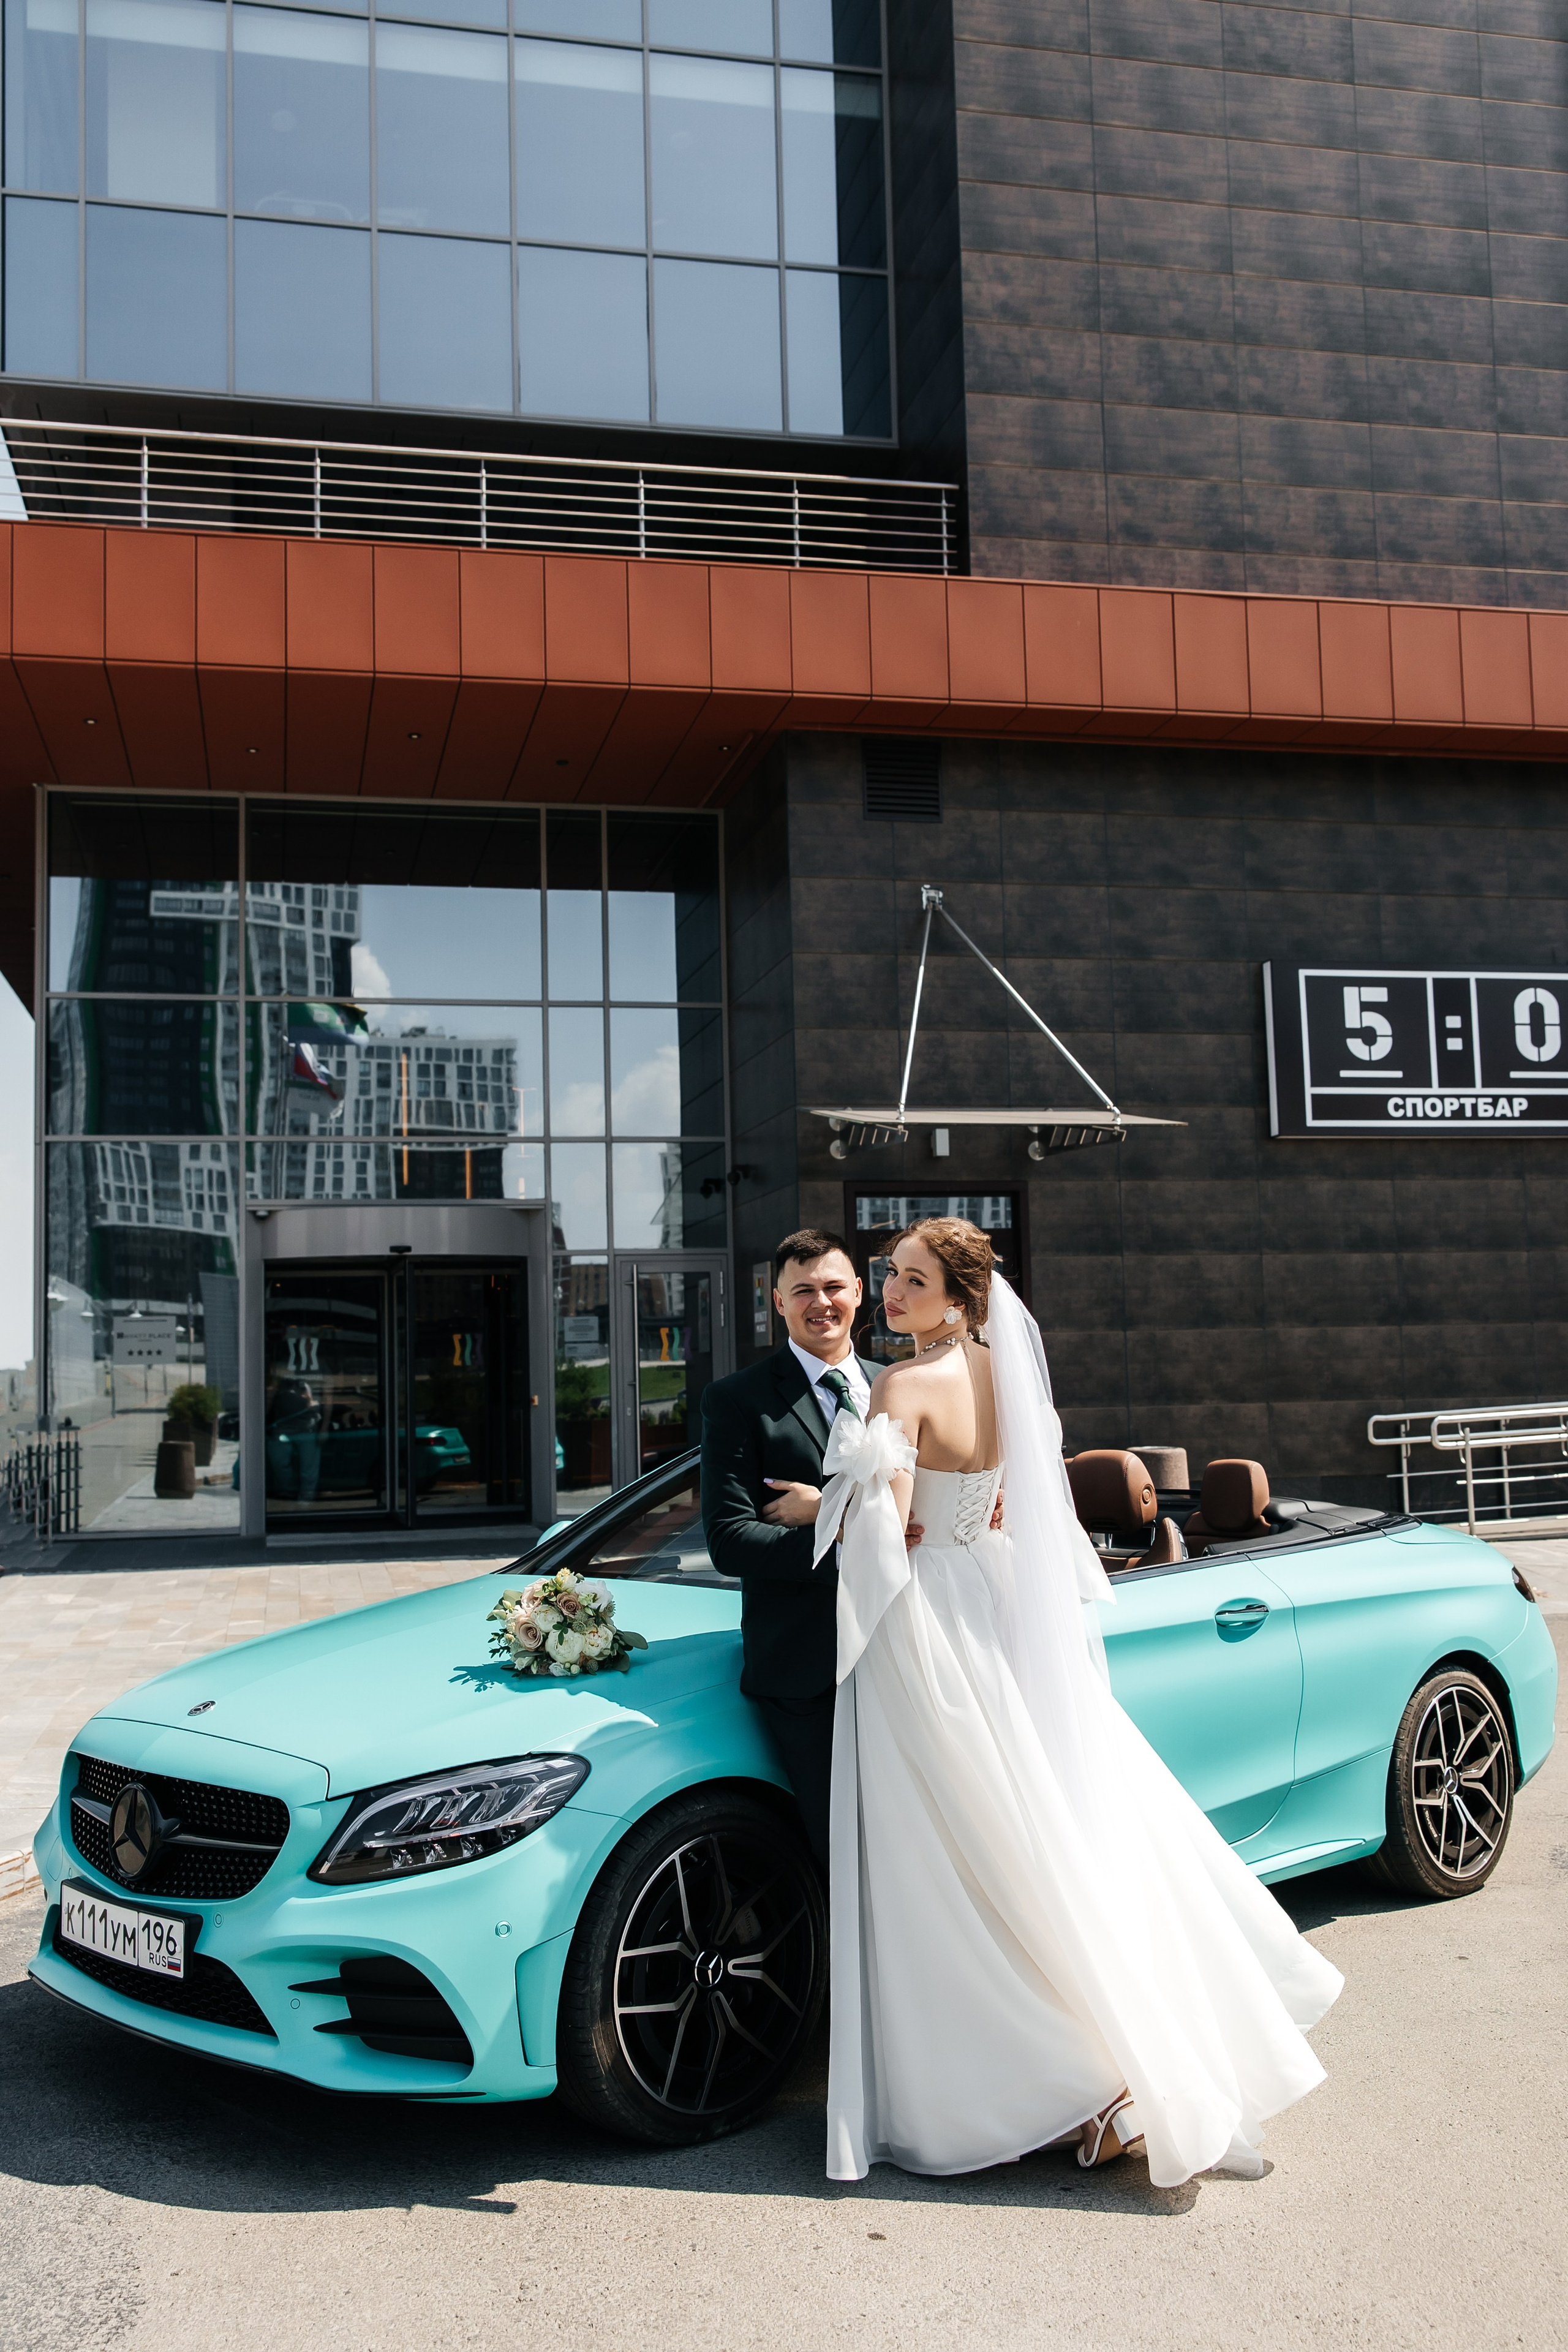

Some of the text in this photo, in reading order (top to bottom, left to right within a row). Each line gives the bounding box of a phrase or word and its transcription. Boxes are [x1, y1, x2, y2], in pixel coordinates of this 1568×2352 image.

[1343, 986, 1393, 1061] 5
[1513, 987, 1562, 1062] 0
[1387, 1096, 1529, 1118] СПОРТБАР
[141, 1919, 177, 1956] 196
[149, 1953, 167, 1967] RUS
